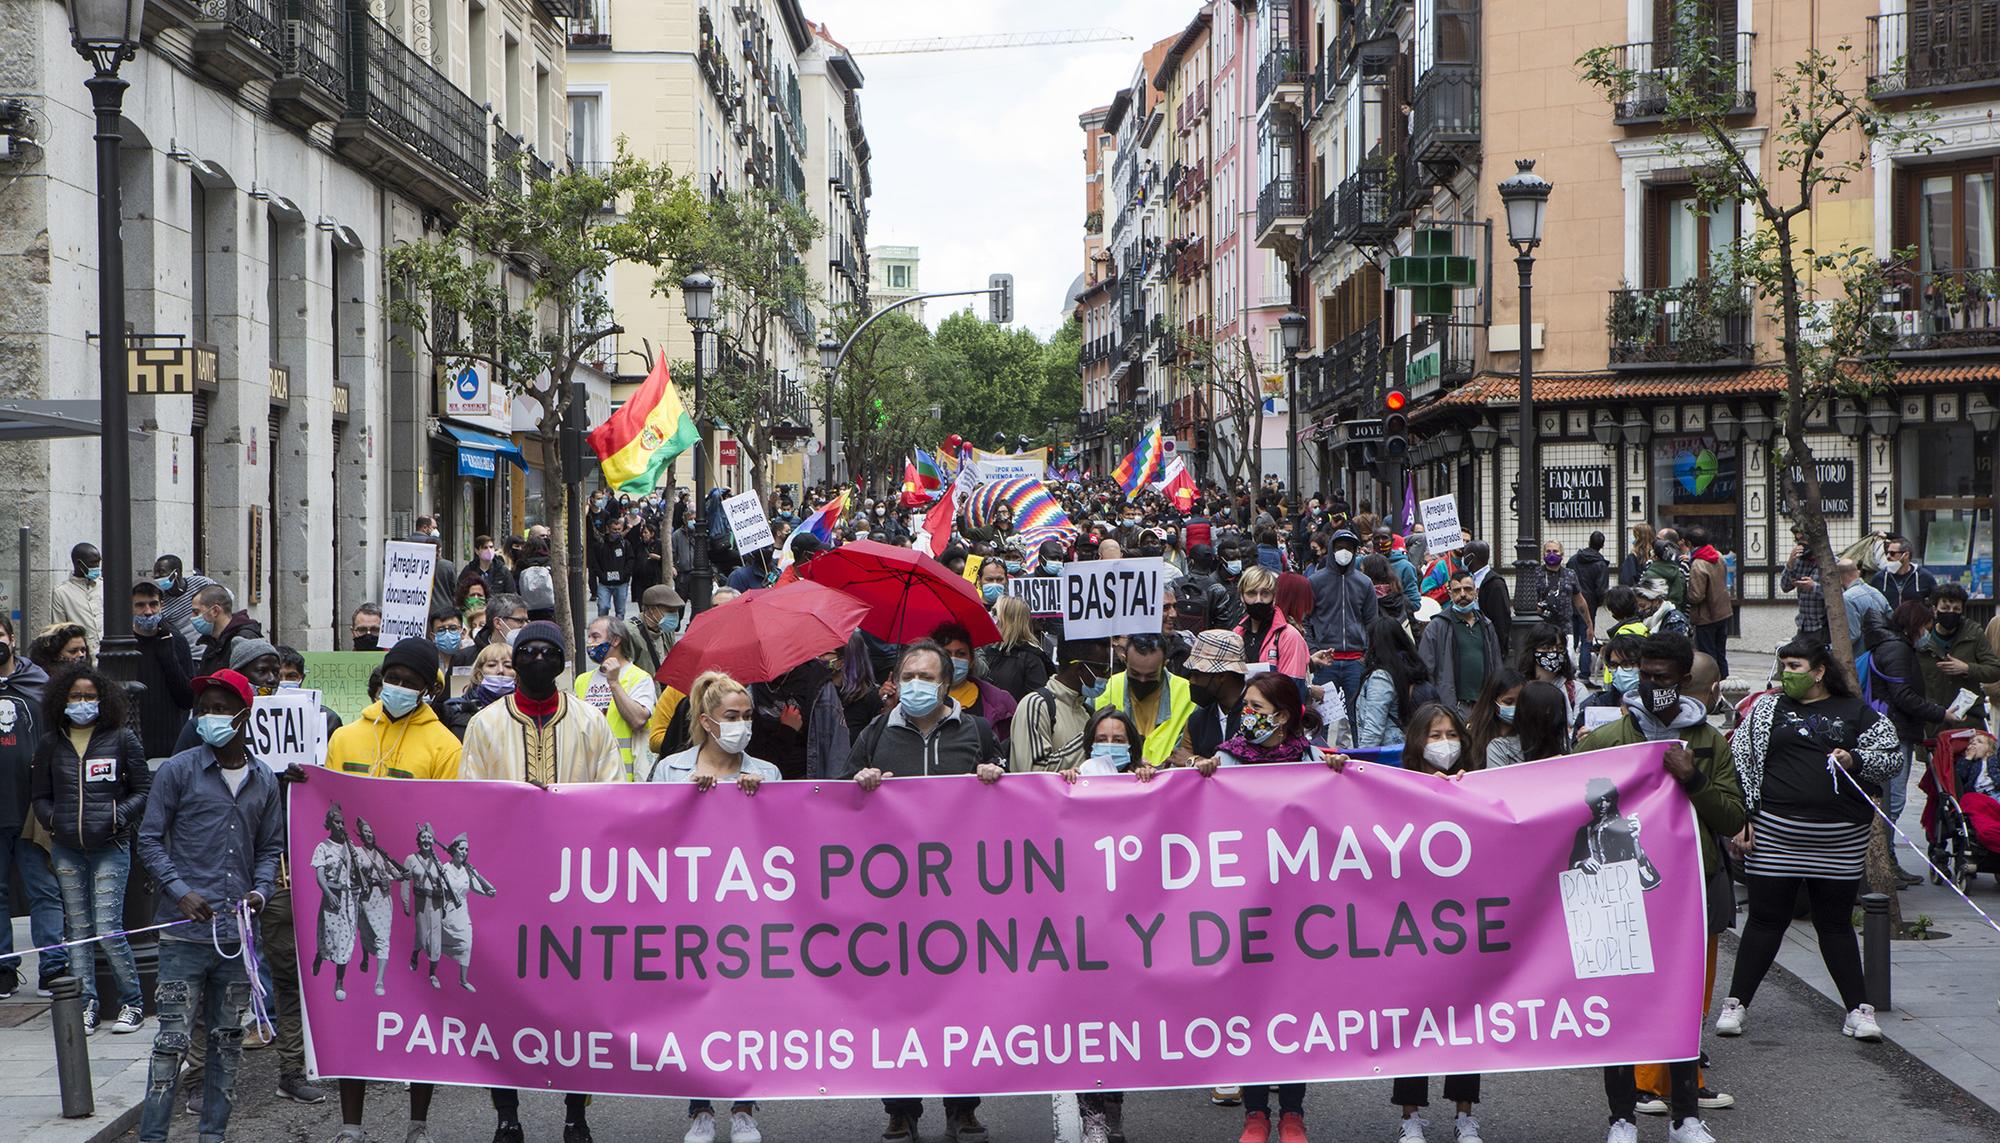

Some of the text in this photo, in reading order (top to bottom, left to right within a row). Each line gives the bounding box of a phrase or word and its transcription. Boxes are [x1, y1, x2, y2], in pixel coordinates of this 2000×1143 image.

[1549, 470, 1604, 490] FARMACIA
[1562, 489, 1590, 500] DE LA
[1549, 501, 1605, 519] FUENTECILLA
[1821, 496, 1849, 512] LÍNICOS
[389, 552, 430, 579] ¡Arreglar ya
[385, 583, 427, 606] documentos
[1068, 570, 1158, 621] BASTA!
[380, 618, 385, 634] a
[244, 707, 304, 756] ASTA!
[549, 846, 797, 904] JUNTAS
[821, 844, 951, 899] POR
[977, 841, 1064, 895] UN
[1161, 829, 1248, 889] DE
[1267, 820, 1473, 885] MAYO
[1562, 865, 1632, 908] POWER
[1570, 901, 1640, 937] TO THE
[518, 896, 1511, 980] INTERSECCIONAL Y DE CLASE
[1575, 934, 1644, 975] PEOPLE
[376, 994, 1612, 1073] PARA QUE LA CRISIS LA PAGUEN LOS CAPITALISTAS
